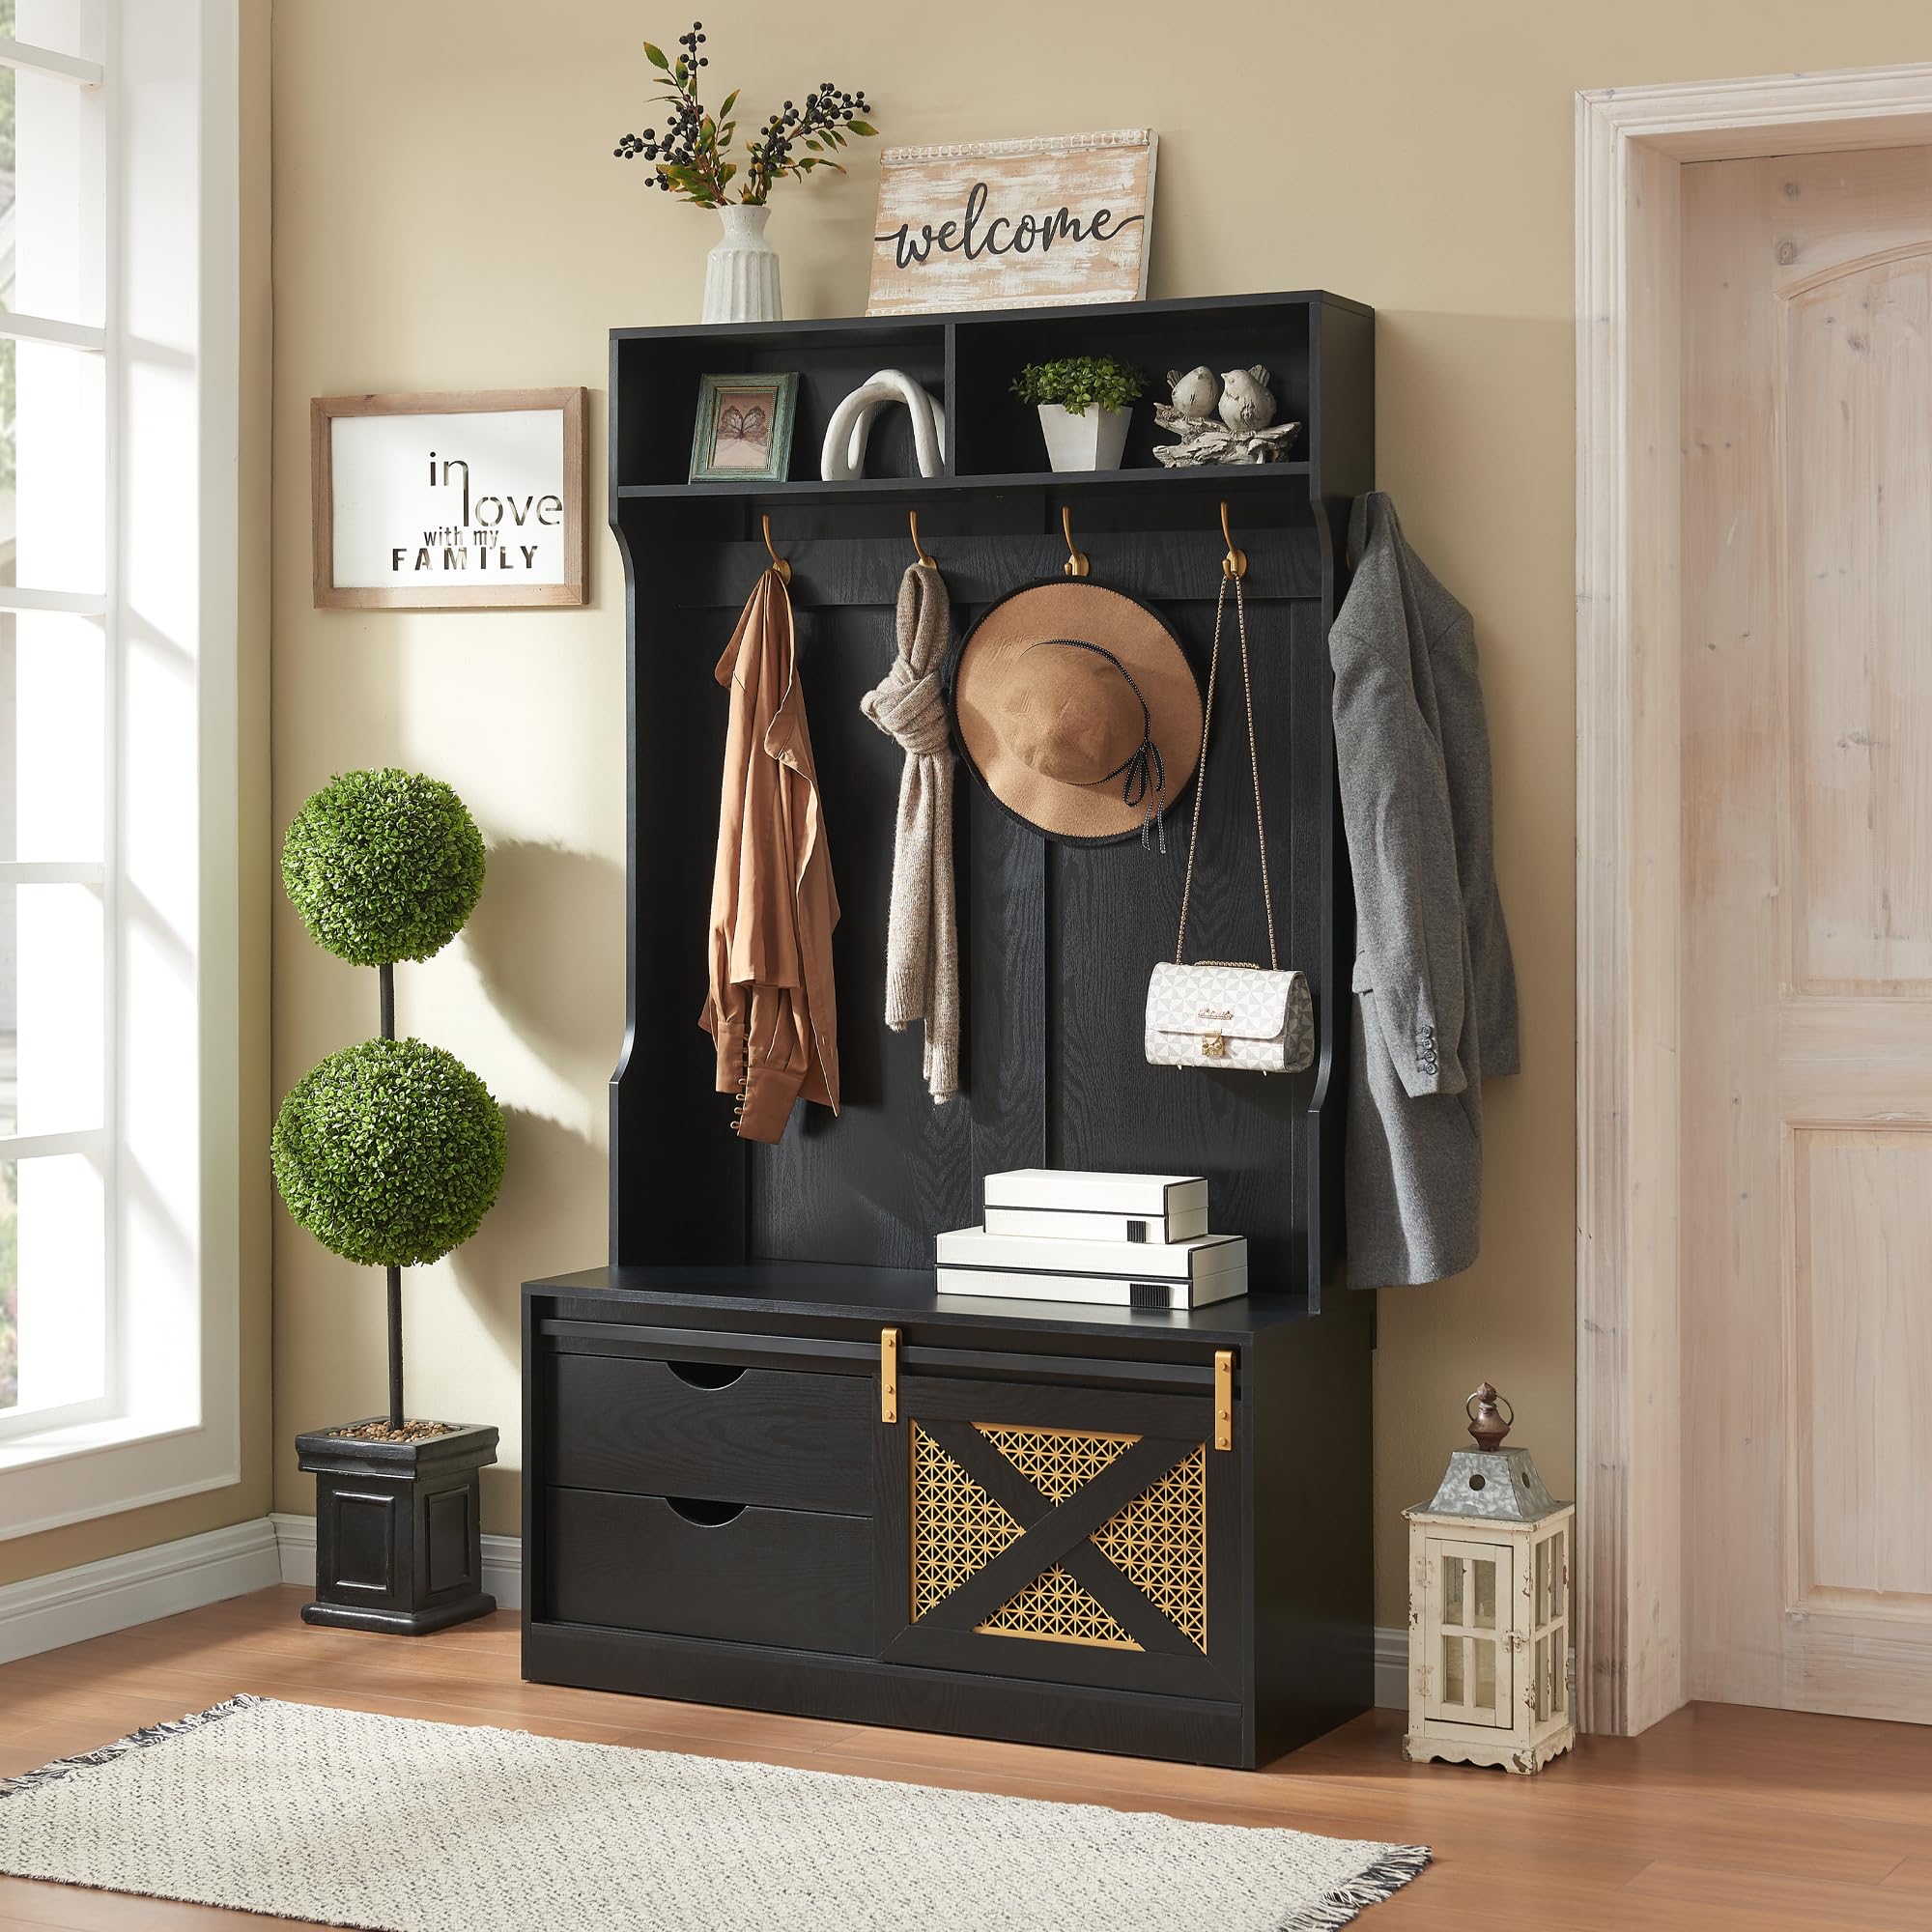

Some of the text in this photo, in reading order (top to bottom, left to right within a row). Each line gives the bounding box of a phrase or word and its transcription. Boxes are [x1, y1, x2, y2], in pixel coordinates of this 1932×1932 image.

[874, 182, 1145, 270] welcome
[429, 451, 469, 498] in
[423, 526, 499, 550] with my
[391, 545, 539, 571] FAMILY
